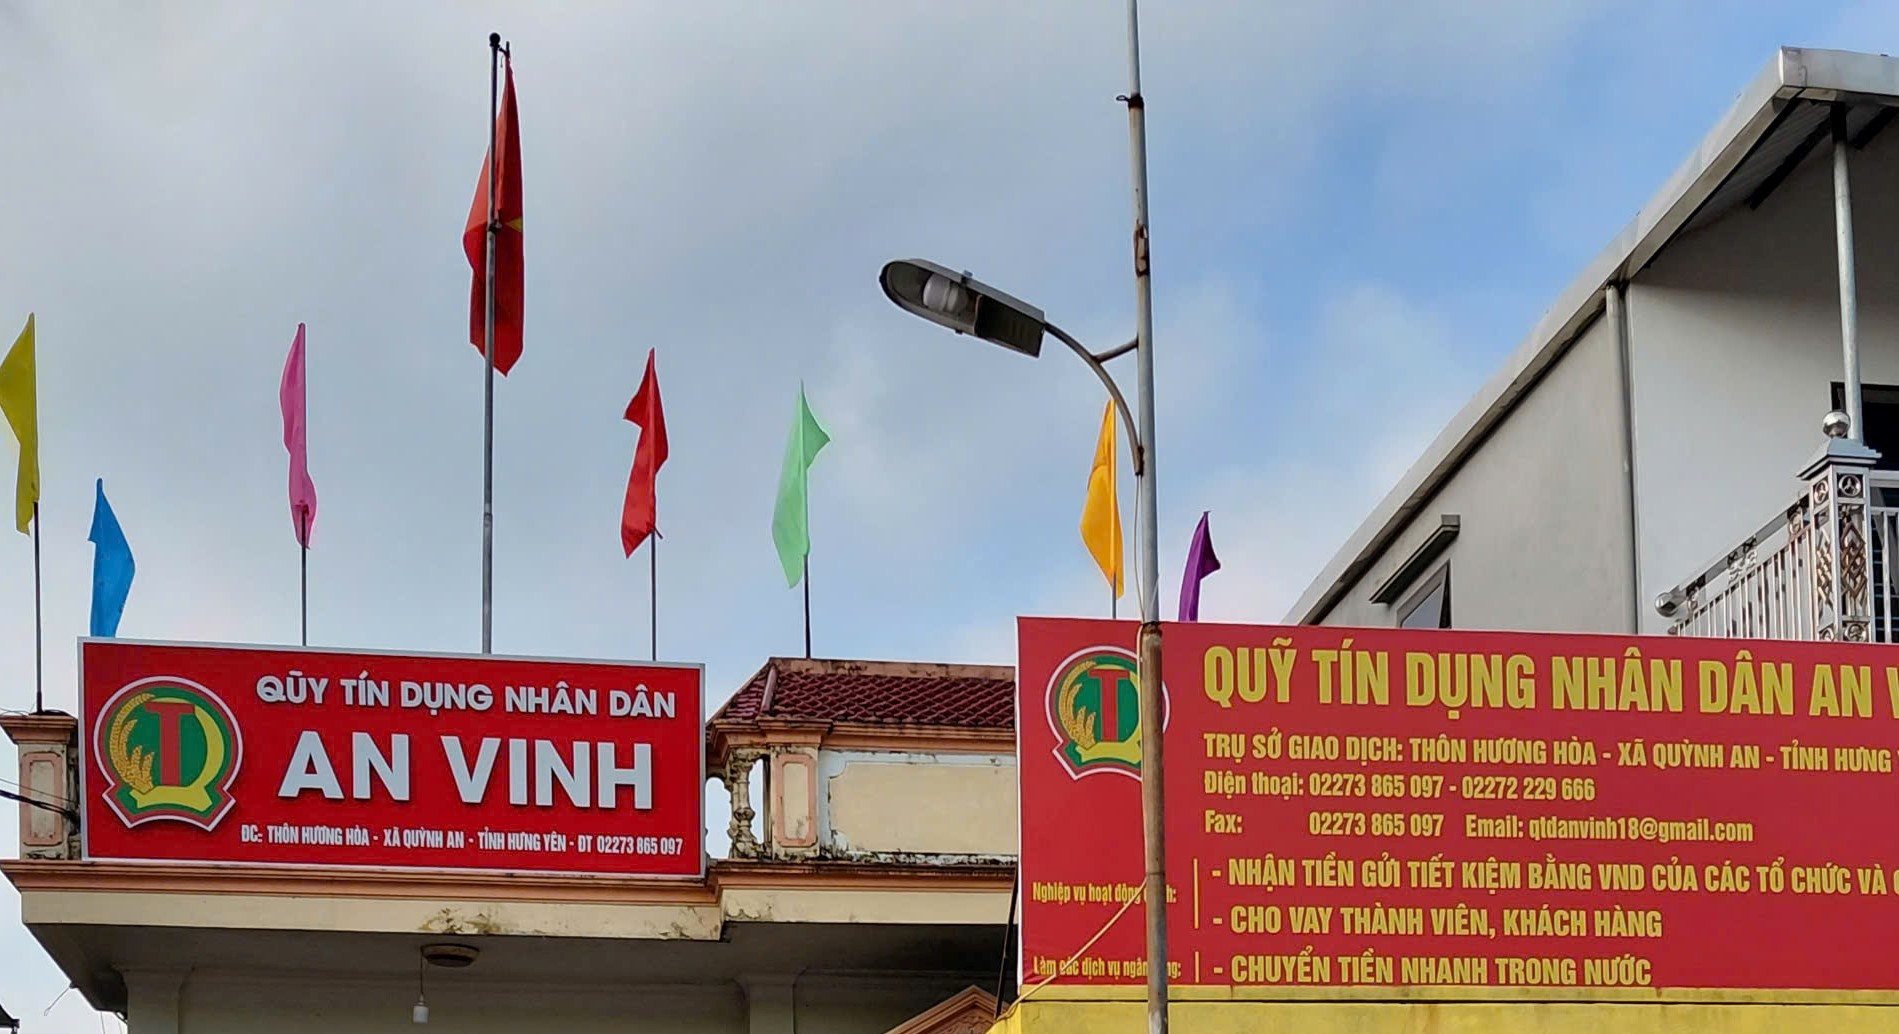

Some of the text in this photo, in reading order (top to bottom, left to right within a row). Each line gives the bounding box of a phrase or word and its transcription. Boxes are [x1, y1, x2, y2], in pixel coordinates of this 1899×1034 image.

[340, 670, 389, 706] TÍN
[401, 681, 493, 715] DỤNG
[505, 681, 597, 714] NHÂN
[610, 684, 675, 718] DÂN
[1205, 637, 1297, 707] QUỸ
[1312, 639, 1389, 705] TÍN
[1406, 652, 1535, 719] DỤNG
[1552, 647, 1682, 711] NHÂN
[1699, 650, 1793, 715] DÂN
[1809, 664, 1872, 717] AN
[1204, 733, 1245, 763] TRỤ
[1253, 727, 1282, 758] SỞ
[1289, 735, 1339, 760] GIAO
[1346, 737, 1403, 766] DỊCH:
[1409, 734, 1466, 762] THÔN
[1473, 738, 1546, 764] HƯƠNG
[1554, 736, 1596, 765] HÒA
[1618, 739, 1646, 766] XÃ
[1653, 739, 1723, 769] QUỲNH
[1730, 745, 1759, 768] AN
[1780, 739, 1828, 770] TỈNH
[1835, 747, 1891, 772] HƯNG
[278, 731, 651, 809] AN VINH
[1205, 771, 1246, 799] Điện
[1252, 772, 1303, 800] thoại:
[1310, 773, 1365, 796] 02273
[1372, 774, 1405, 797] 865
[1410, 775, 1443, 798] 097
[1462, 776, 1518, 799] 02272
[1523, 777, 1556, 799] 229
[1562, 778, 1595, 800] 666
[267, 823, 299, 843] THÔN
[302, 826, 342, 845] HƯƠNG
[346, 825, 369, 846] HÒA
[384, 827, 400, 847] XÃ
[403, 827, 443, 848] QUỲNH
[447, 831, 464, 848] AN
[478, 827, 505, 849] TỈNH
[508, 832, 541, 851] HƯNG
[543, 831, 566, 852] YÊN
[597, 836, 634, 853] 02273
[637, 837, 657, 854] 865
[660, 837, 683, 854] 097
[1205, 810, 1444, 836] Fax: 02273 865 097
[1466, 815, 1753, 842] Email: qtdanvinh18@gmail.com
[1229, 854, 1294, 891] NHẬN
[1302, 852, 1354, 886] TIỀN
[1362, 852, 1400, 887] GỬI
[1407, 853, 1455, 887] TIẾT
[1462, 857, 1520, 894] KIỆM
[1528, 853, 1591, 889] BẰNG
[1598, 864, 1644, 890] VND
[1652, 856, 1698, 891] CỦA
[1705, 861, 1750, 892] CÁC
[1756, 857, 1784, 892] TỔ
[1791, 863, 1851, 894] CHỨC
[1857, 864, 1887, 894] VÀ
[1033, 882, 1070, 904] Nghiệp
[1073, 886, 1086, 905] vụ
[1089, 883, 1112, 905] hoạt
[1231, 906, 1281, 933] CHO
[1289, 907, 1332, 933] VAY
[1340, 902, 1423, 934] THÀNH
[1431, 903, 1495, 939] VIÊN,
[1504, 904, 1586, 936] KHÁCH
[1594, 905, 1662, 937] HÀNG
[1034, 956, 1056, 976] Làm
[1082, 957, 1105, 979] dịch
[1108, 961, 1120, 979] vụ
[1232, 945, 1330, 982] CHUYỂN
[1338, 948, 1393, 983] TIỀN
[1401, 957, 1487, 986] NHANH
[1495, 959, 1576, 986] TRONG
[1583, 955, 1651, 985] NƯỚC
